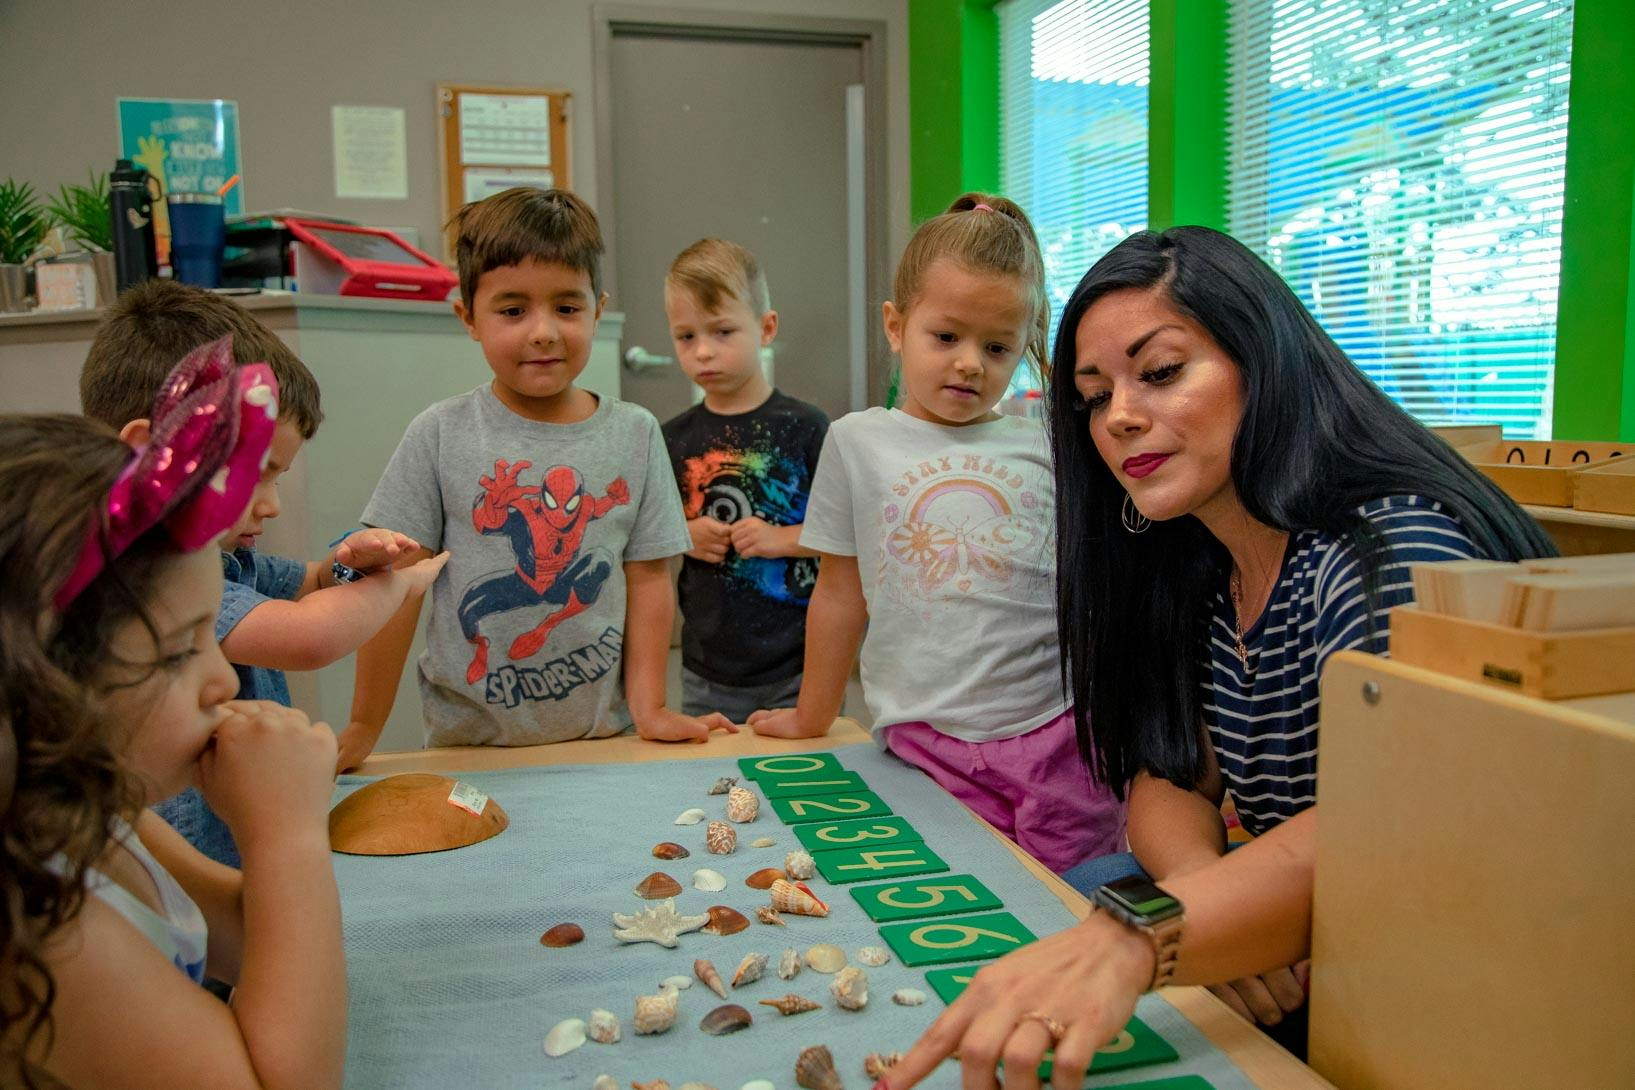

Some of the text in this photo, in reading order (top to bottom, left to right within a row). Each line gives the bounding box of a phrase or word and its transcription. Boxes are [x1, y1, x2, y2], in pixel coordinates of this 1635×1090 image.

[892, 455, 952, 497] STAY
[755, 756, 825, 773] 0
[788, 798, 871, 816] 2
[815, 825, 899, 843] 3
[836, 849, 927, 870] 4
[876, 886, 978, 908] 5
[909, 924, 1021, 949] 6
